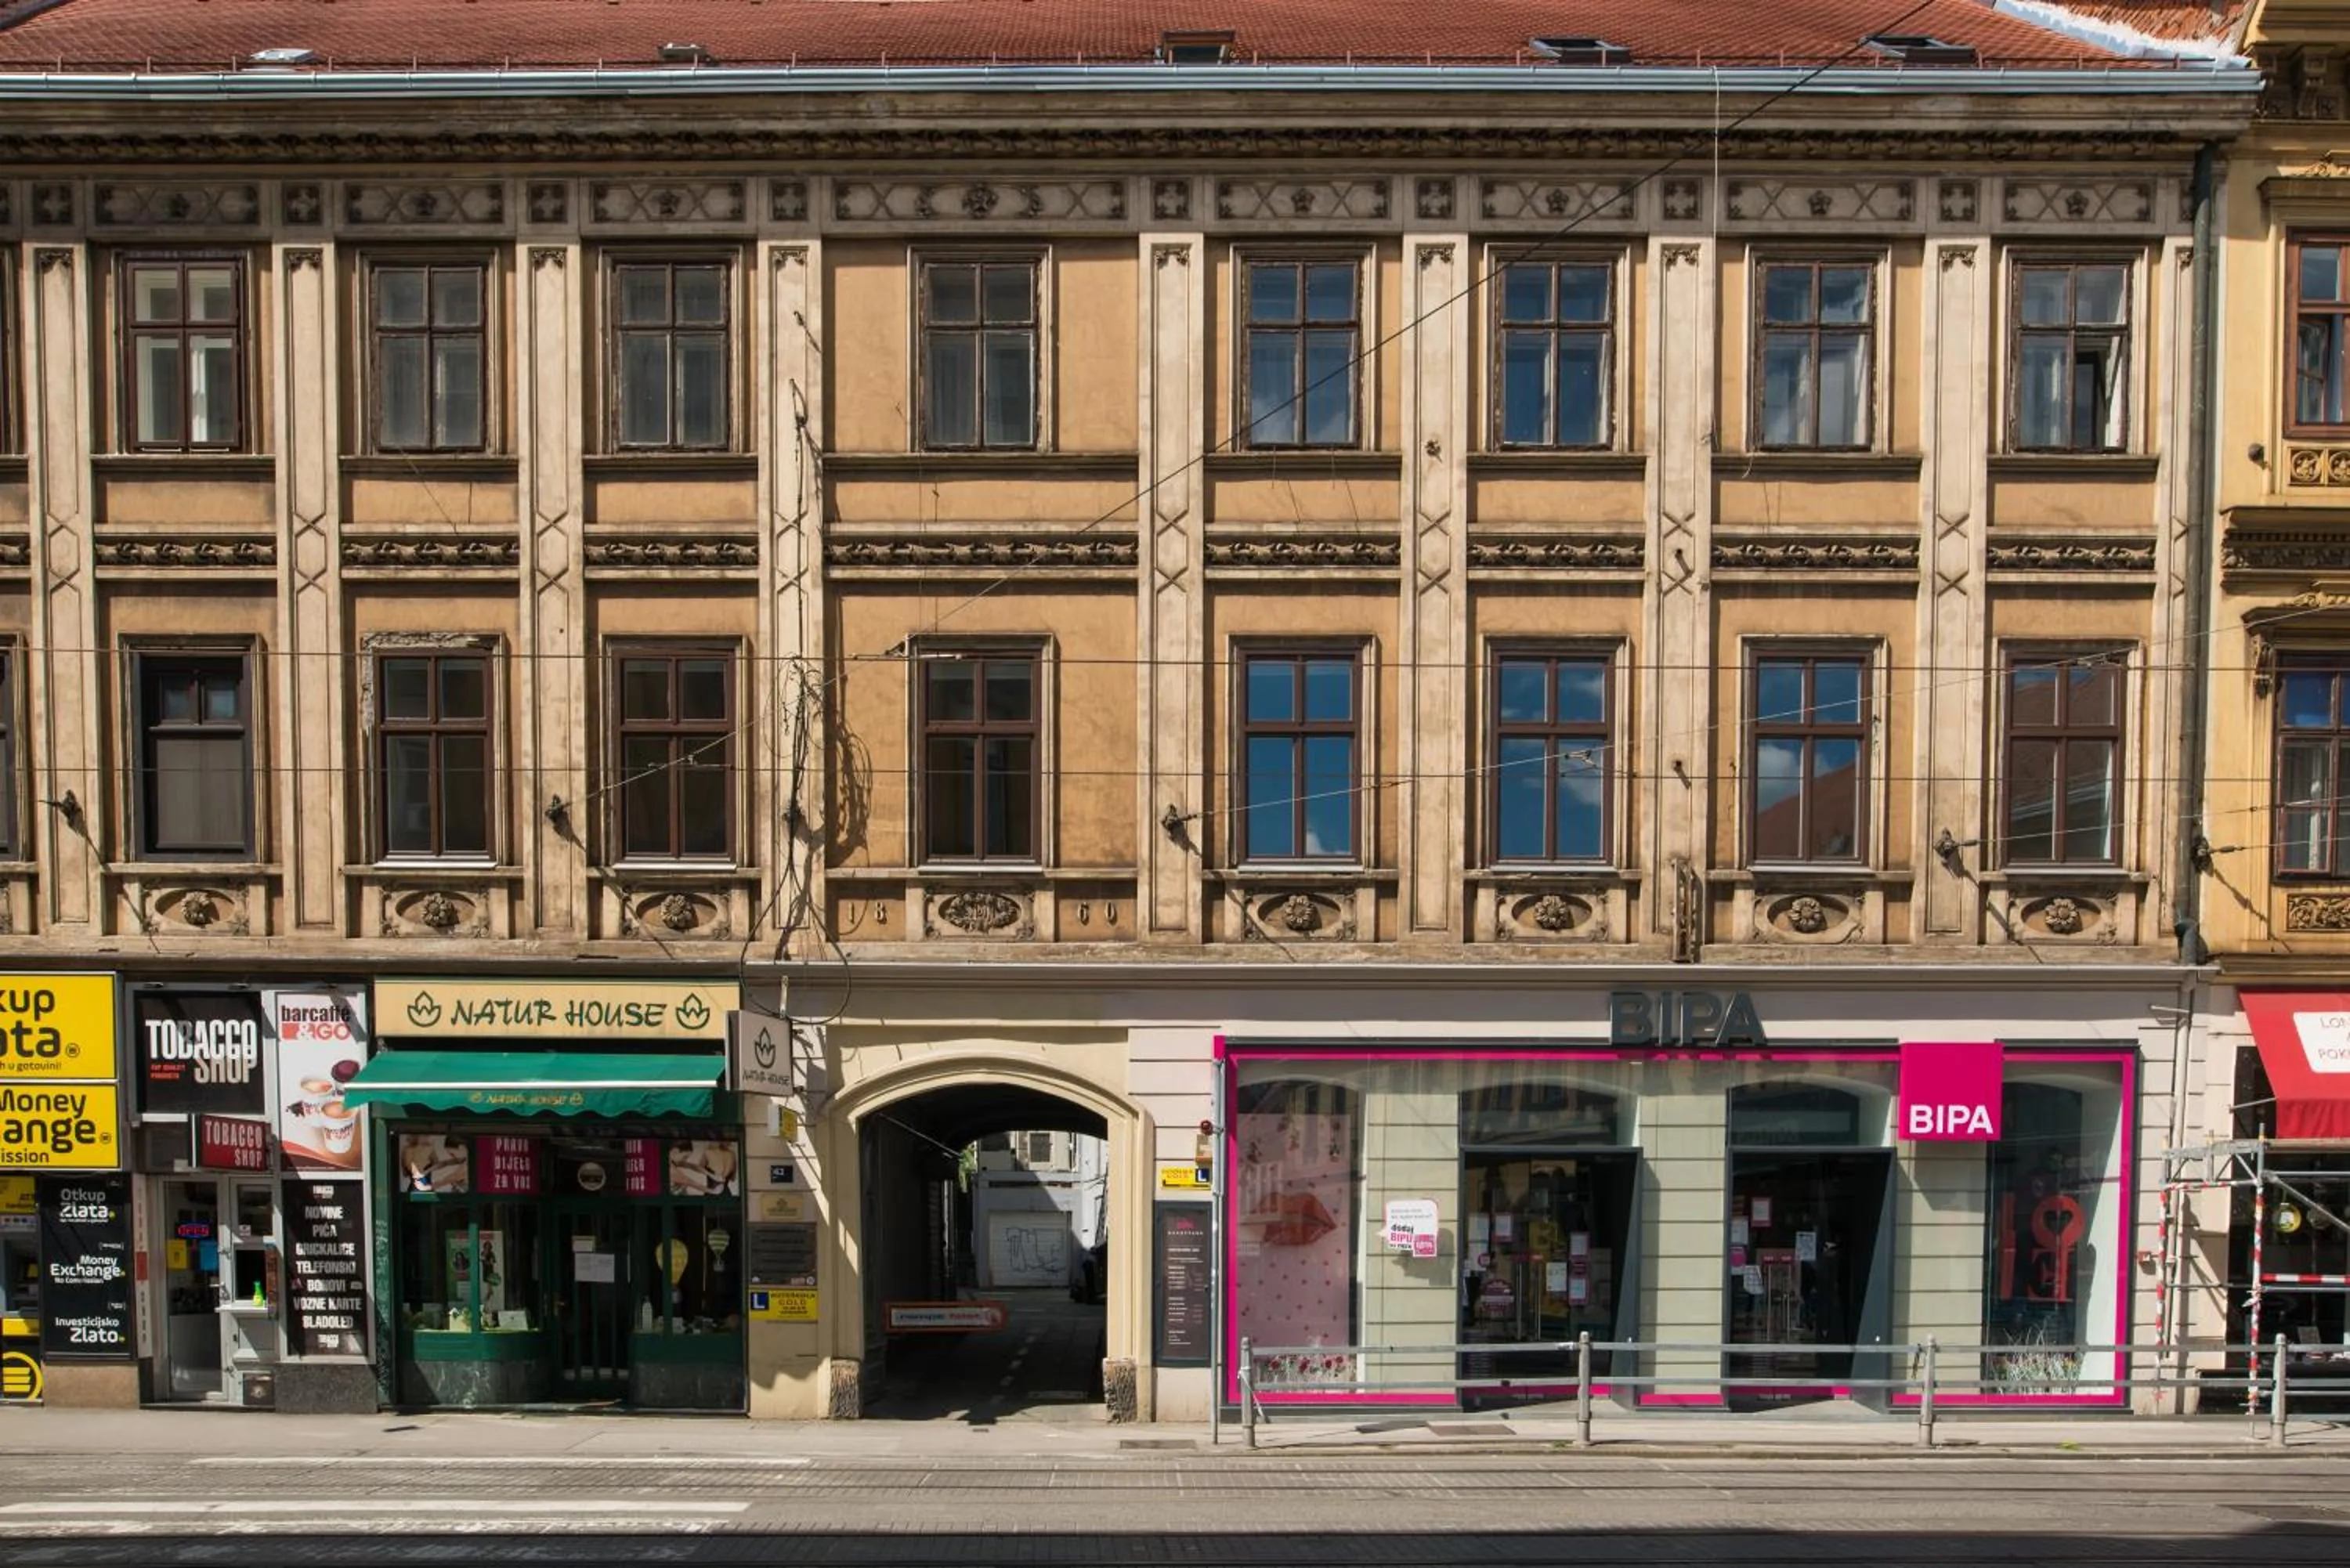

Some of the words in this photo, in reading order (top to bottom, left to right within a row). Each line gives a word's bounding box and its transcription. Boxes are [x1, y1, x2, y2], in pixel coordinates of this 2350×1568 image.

[450, 998, 557, 1027] NATUR
[564, 998, 667, 1028] HOUSE
[1609, 991, 1768, 1046] BIPA
[145, 1019, 258, 1060] TOBACCO
[193, 1044, 258, 1084] SHOP
[1909, 1104, 1994, 1134] BIPA
[204, 1120, 263, 1149] TOBACCO
[234, 1147, 262, 1168] SHOP
[60, 1187, 107, 1204] Otkup
[305, 1205, 344, 1219] NOVINE
[79, 1254, 118, 1266] Money
[295, 1260, 356, 1274] TELEFONSKI
[49, 1263, 121, 1281] Exchange
[293, 1296, 327, 1310] VOZNE
[328, 1296, 363, 1310] KARTE
[753, 1292, 765, 1309] L
[69, 1326, 119, 1343] Zlato
